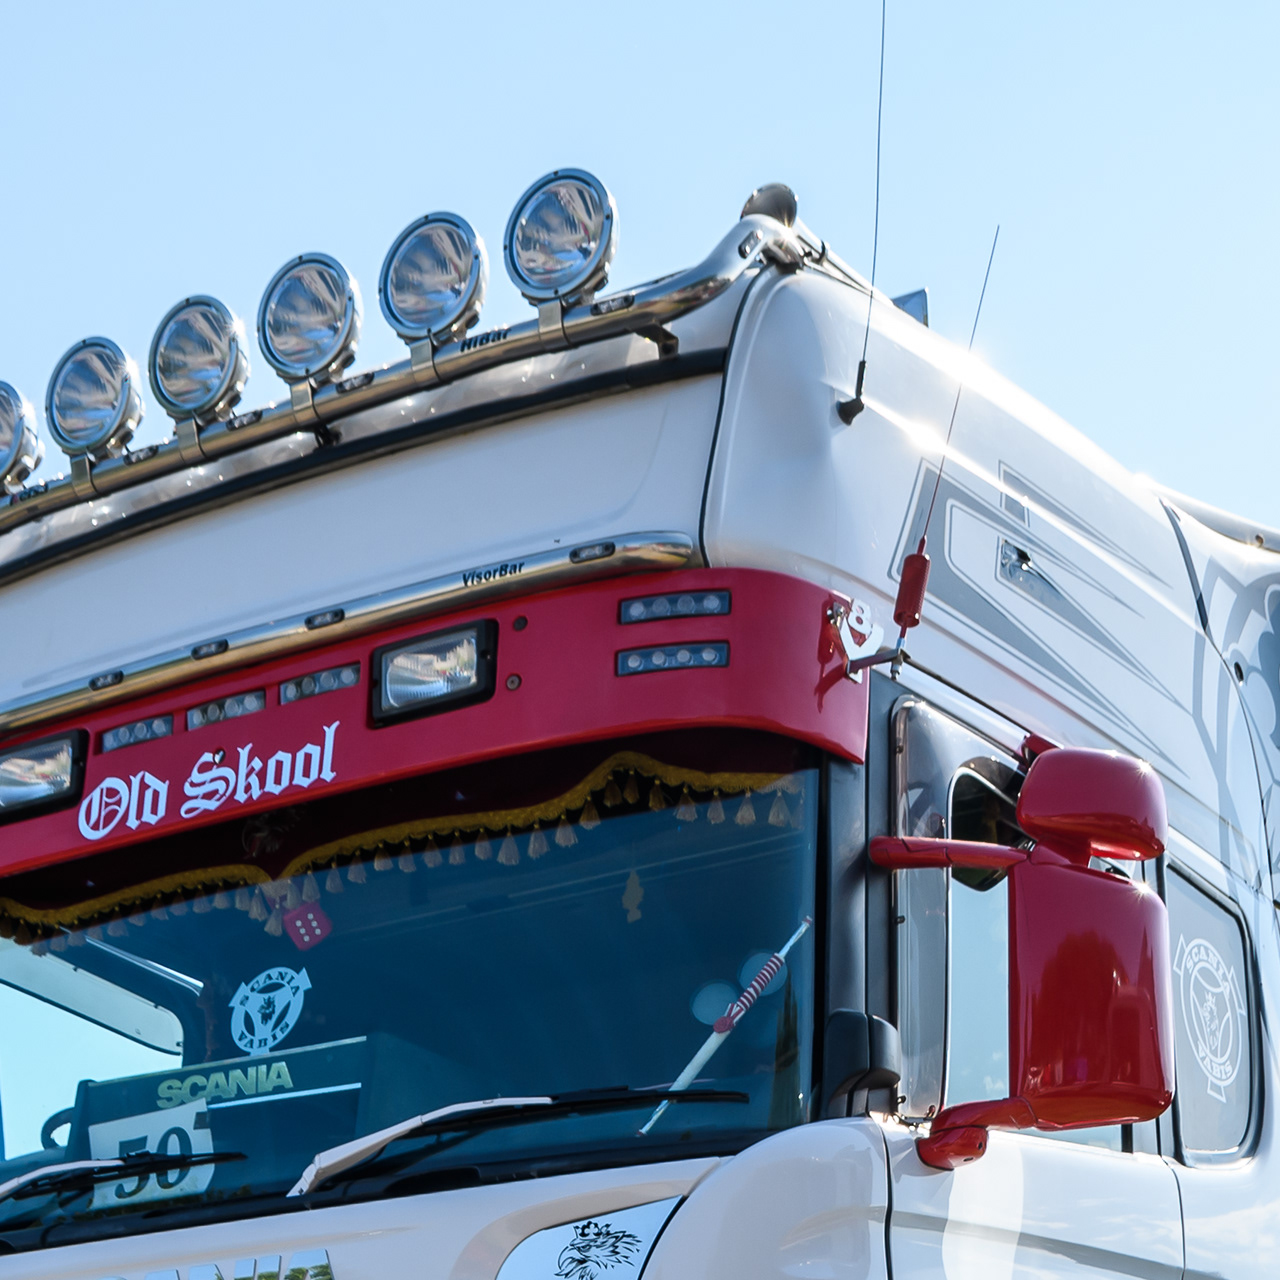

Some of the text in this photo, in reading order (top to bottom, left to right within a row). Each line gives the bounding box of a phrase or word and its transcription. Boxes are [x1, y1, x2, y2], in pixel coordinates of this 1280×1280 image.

[462, 562, 525, 588] VisorBar
[78, 720, 340, 841] Old Skool
[1185, 945, 1231, 1001] SCANIA
[156, 1060, 294, 1109] SCANIA
[1196, 1039, 1234, 1079] VABIS
[115, 1126, 193, 1199] 50
